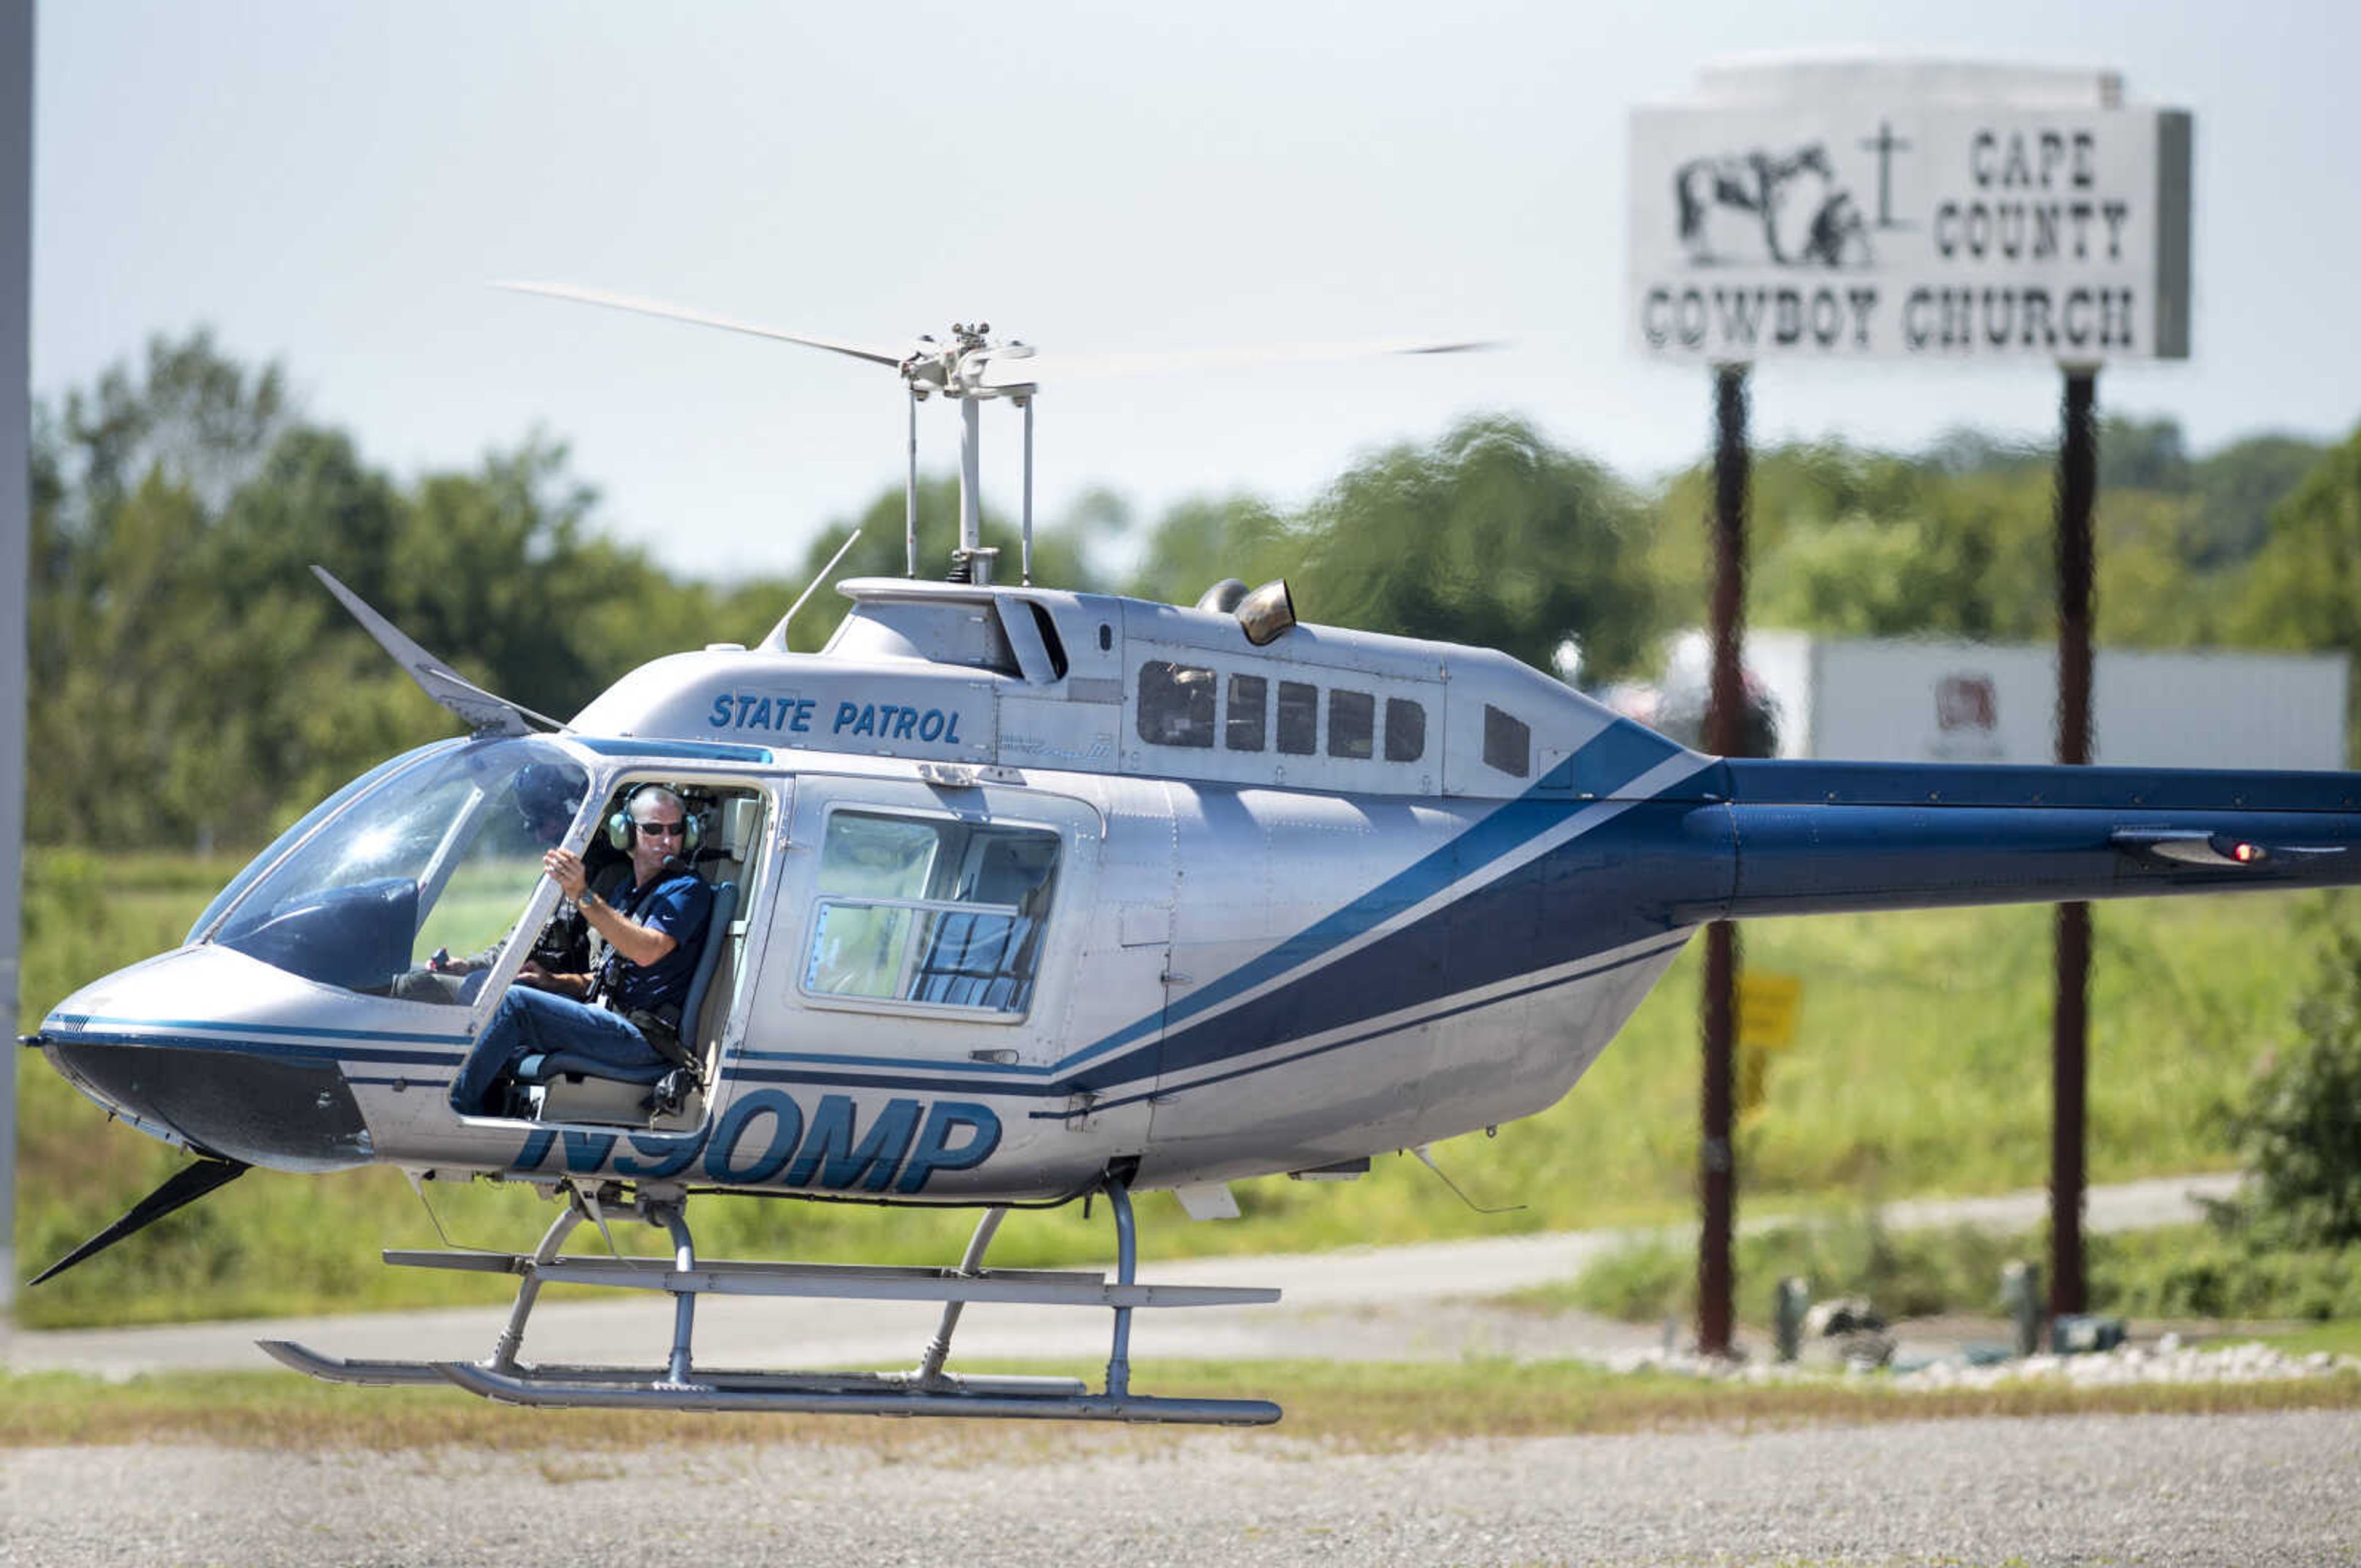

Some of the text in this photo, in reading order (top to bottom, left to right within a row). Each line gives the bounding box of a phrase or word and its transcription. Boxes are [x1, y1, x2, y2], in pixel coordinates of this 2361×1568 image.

[1972, 130, 2095, 188] CAPE
[1936, 202, 2129, 259] COUNTY
[1644, 285, 2135, 349] COWBOY CHURCH
[708, 695, 960, 744] STATE PATROL
